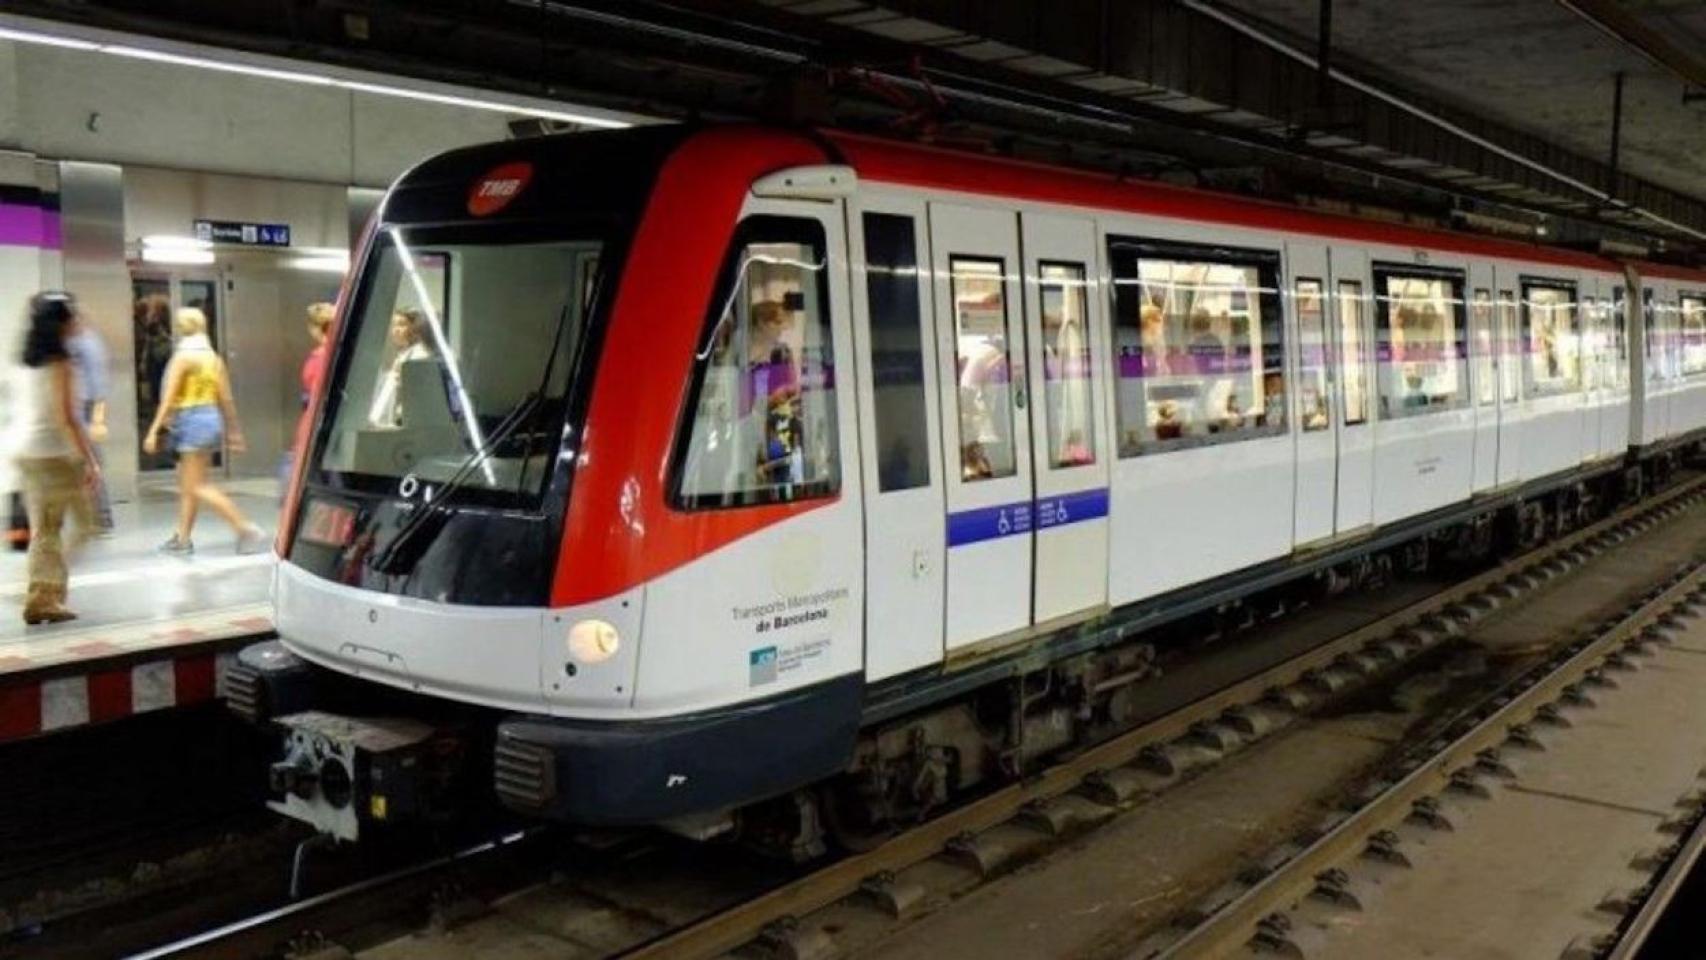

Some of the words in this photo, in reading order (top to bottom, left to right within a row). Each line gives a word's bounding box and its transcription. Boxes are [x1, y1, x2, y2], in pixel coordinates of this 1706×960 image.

[479, 179, 520, 197] TMB
[732, 602, 786, 620] Transports
[756, 620, 770, 632] de
[774, 608, 828, 629] Barcelona
